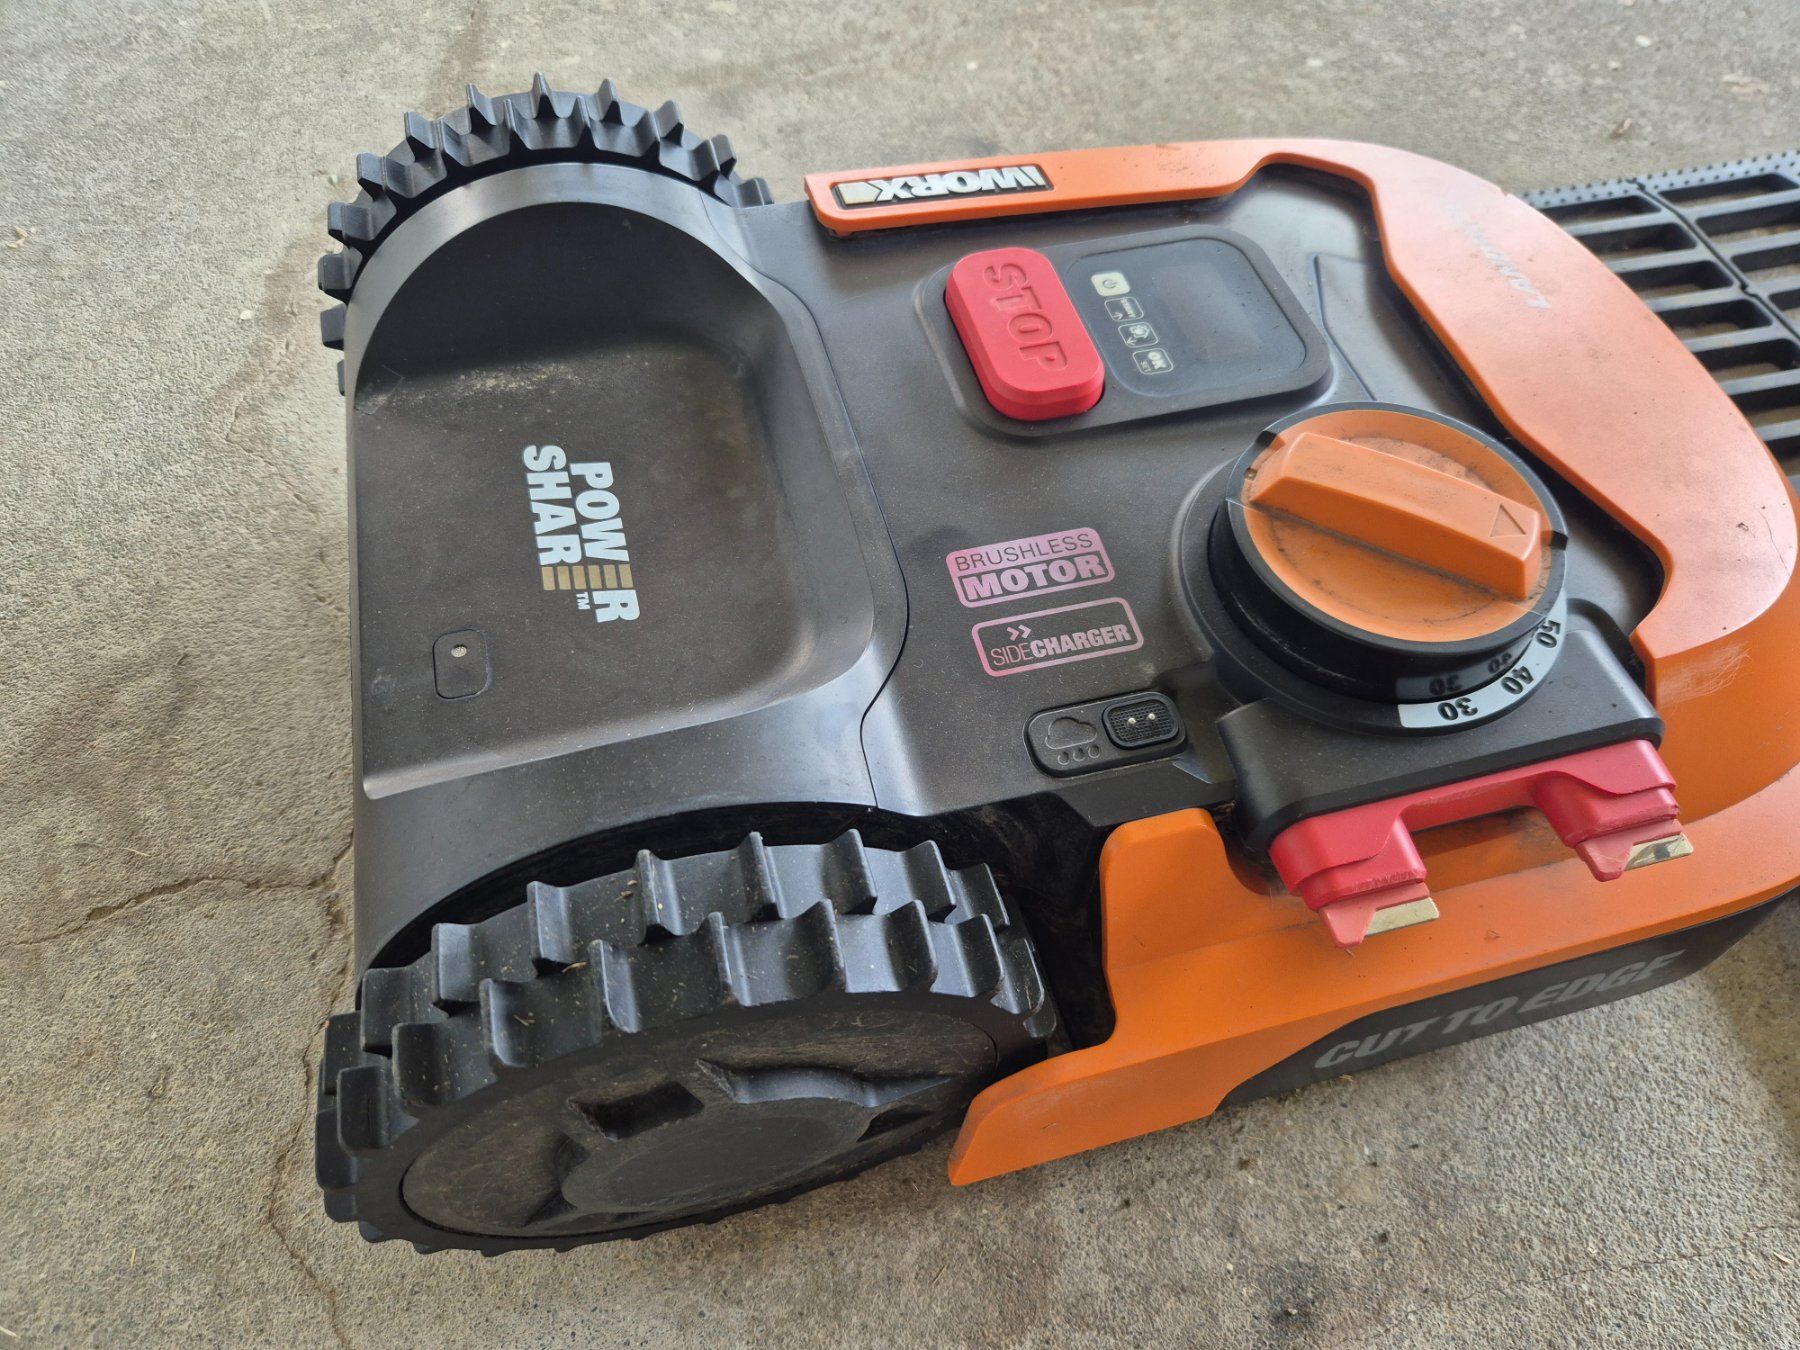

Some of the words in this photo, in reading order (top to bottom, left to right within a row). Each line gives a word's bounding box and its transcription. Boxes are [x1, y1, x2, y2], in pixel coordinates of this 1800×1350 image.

[869, 165, 1047, 202] WORX
[983, 263, 1068, 371] STOP
[1147, 351, 1167, 370] OK
[523, 444, 587, 591] SHARE
[569, 461, 641, 623] POWER
[955, 533, 1094, 572] BRUSHLESS
[961, 554, 1106, 601] MOTOR
[990, 623, 1132, 667] SIDECHARGER
[1535, 619, 1561, 649] 50
[1501, 665, 1534, 695] 40
[1437, 697, 1479, 721] 30
[1314, 1016, 1442, 1070] CUT
[1442, 996, 1520, 1035] TO
